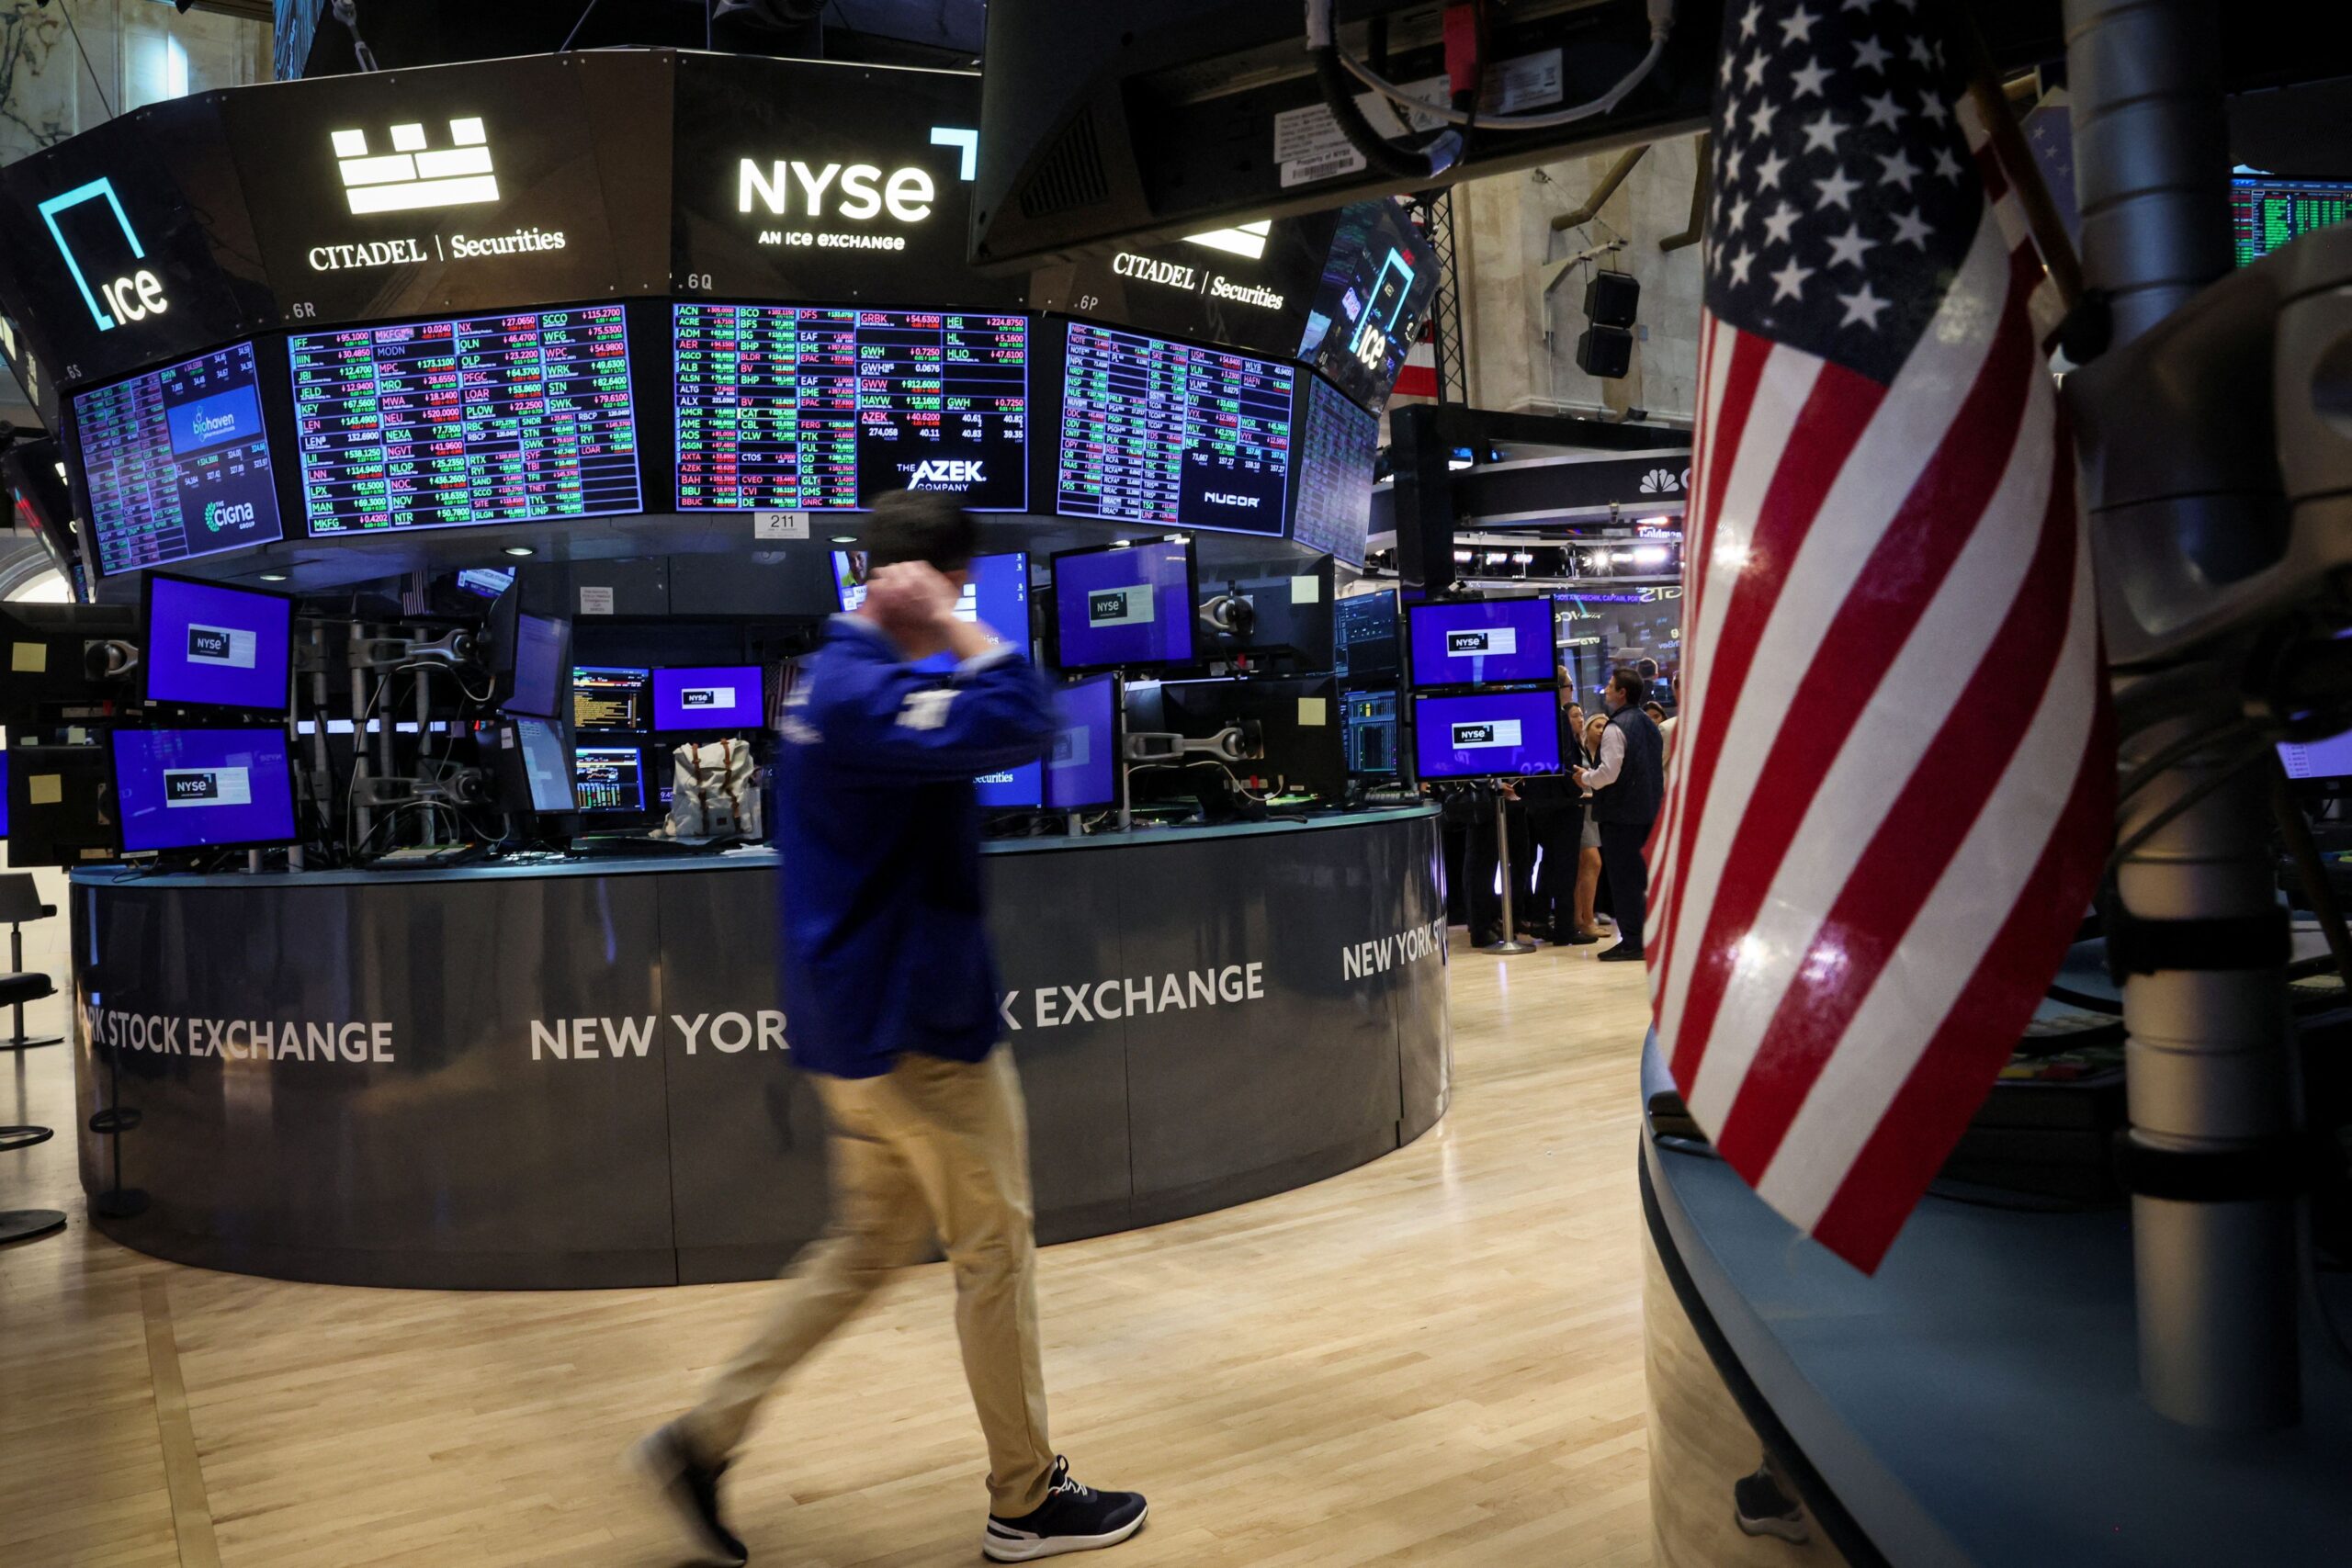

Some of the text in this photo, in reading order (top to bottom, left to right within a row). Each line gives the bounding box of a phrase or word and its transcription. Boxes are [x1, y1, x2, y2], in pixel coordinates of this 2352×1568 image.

[758, 231, 781, 244] AN
[309, 228, 566, 271] CITADEL Securities
[688, 274, 712, 290] 6Q
[1113, 253, 1283, 310] CITADEL Securities
[1080, 294, 1099, 310] 6P
[293, 303, 316, 319] 6R
[679, 307, 698, 315] ACN
[740, 309, 760, 318] BCO
[800, 310, 818, 319] DFS
[542, 313, 568, 325] SCCO
[861, 313, 888, 323] GRBK
[947, 317, 963, 326] HEI
[458, 322, 471, 332] NX
[544, 331, 567, 342] WFG
[679, 329, 700, 338] ADM
[741, 331, 753, 340] BG
[800, 333, 818, 341] EAF
[947, 333, 959, 343] HL
[294, 338, 308, 347] IFF
[460, 339, 480, 349] OLN
[679, 341, 698, 349] AER
[741, 342, 759, 351] BHP
[378, 346, 405, 356] MODN
[546, 348, 568, 358] WPC
[861, 346, 885, 356] GWH
[947, 349, 969, 359] HLIO
[461, 355, 480, 366] OLP
[379, 363, 399, 373] MPC
[547, 365, 570, 375] WRK
[679, 363, 698, 372] ALB
[741, 365, 753, 373] BV
[1190, 365, 1204, 375] VLN
[298, 371, 311, 380] JBI
[463, 372, 487, 382] PFGC
[380, 379, 401, 389] MRO
[548, 381, 568, 392] STN
[861, 379, 888, 389] GWW
[300, 387, 322, 397] JELD
[465, 389, 490, 400] LOAR
[382, 397, 405, 406] MWA
[550, 399, 572, 409] SWK
[680, 397, 698, 405] ALX
[861, 396, 891, 405] HAYW
[947, 398, 971, 407] GWH
[301, 404, 319, 413] KFY
[466, 405, 493, 416] PLOW
[384, 412, 403, 423] NEU
[578, 412, 597, 421] RBCP
[861, 412, 888, 421] AZEK
[192, 413, 234, 434] biohaven
[303, 420, 321, 430] LEN
[466, 422, 483, 432] RBC
[386, 429, 412, 440] NEXA
[523, 429, 540, 438] STN
[741, 432, 761, 440] CLW
[801, 432, 819, 441] FTK
[525, 440, 544, 449] SWK
[388, 446, 413, 457] NGVT
[582, 446, 601, 455] LOAR
[307, 454, 317, 463] LII
[469, 456, 487, 465] RTX
[390, 462, 413, 473] NLOP
[681, 464, 702, 472] AZEK
[801, 465, 814, 474] GE
[309, 470, 327, 479] LNN
[908, 460, 985, 491] AZEK
[390, 479, 412, 489] NOC
[529, 484, 547, 492] TNET
[918, 483, 969, 491] COMPANY
[311, 486, 327, 495] LPX
[392, 496, 413, 505] NOV
[530, 495, 546, 504] TYL
[1204, 491, 1258, 508] NUCOR
[311, 502, 333, 512] MAN
[313, 518, 339, 528] MKFG
[395, 513, 413, 523] NTR
[771, 514, 794, 527] 211
[239, 521, 255, 530] GROUP
[1343, 937, 1392, 981] NEW
[1396, 923, 1432, 965] YORK
[1035, 962, 1264, 1027] EXCHANGE
[88, 1006, 395, 1063] RK STOCK EXCHANGE
[531, 1010, 791, 1060] NEW YOR
